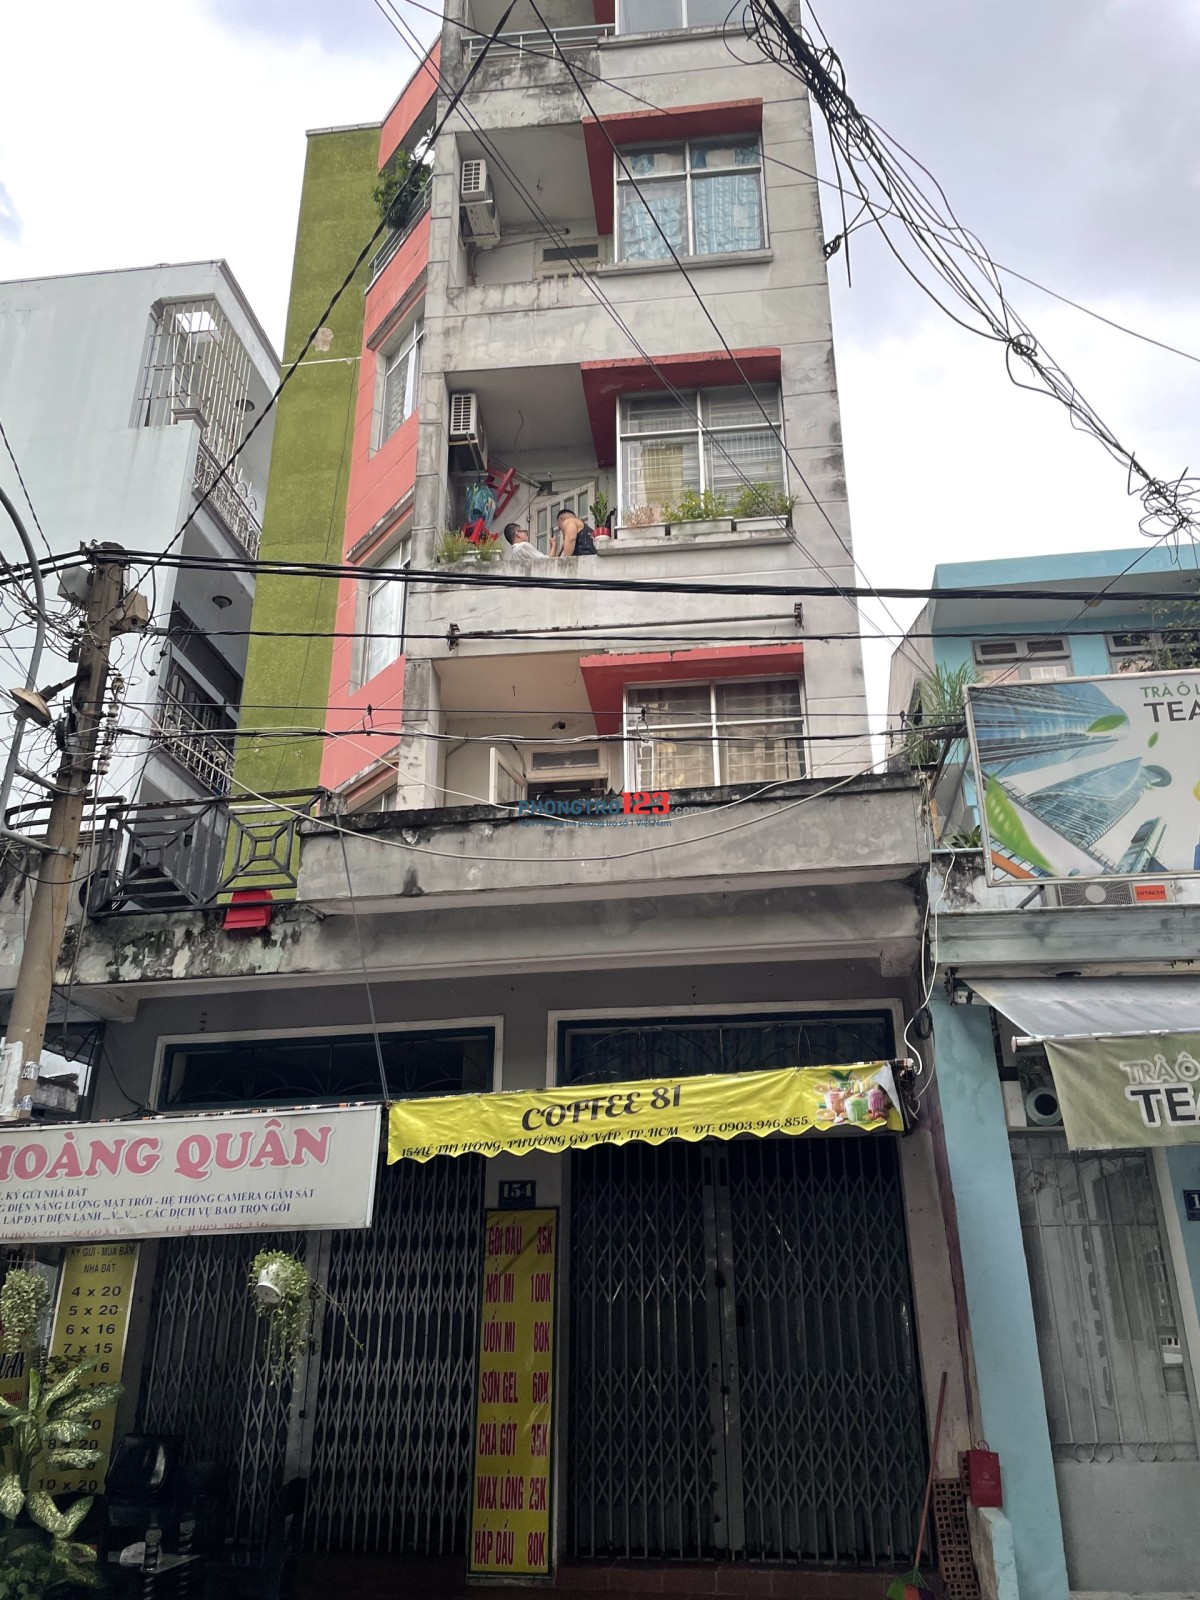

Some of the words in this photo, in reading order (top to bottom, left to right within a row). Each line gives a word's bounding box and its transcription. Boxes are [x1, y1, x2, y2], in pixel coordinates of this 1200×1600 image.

[1139, 682, 1174, 698] TRÀ
[1176, 681, 1191, 696] Ô
[1119, 1054, 1178, 1084] TRÀ
[521, 1091, 644, 1132] COFFEE
[650, 1084, 682, 1110] 81
[1127, 1085, 1200, 1125] TE
[174, 1118, 333, 1180] QUÂN
[217, 1191, 261, 1203] CAMERA
[503, 1183, 532, 1198] 154
[215, 1204, 237, 1216] BAO
[537, 1225, 553, 1255] 35K
[71, 1286, 81, 1298] 4
[87, 1288, 97, 1297] x
[101, 1285, 122, 1298] 20
[503, 1273, 515, 1303] MI
[530, 1272, 551, 1303] 100K
[68, 1305, 78, 1316] 5
[83, 1307, 93, 1316] x
[98, 1304, 119, 1316] 20
[65, 1324, 75, 1335] 6
[80, 1326, 90, 1335] x
[97, 1323, 116, 1335] 16
[503, 1321, 516, 1353] MI
[533, 1321, 551, 1353] 80K
[63, 1343, 73, 1354] 7
[78, 1345, 87, 1354] x
[94, 1342, 113, 1354] 15
[502, 1371, 518, 1403] GEL
[532, 1371, 549, 1403] 60K
[79, 1439, 99, 1450] 20
[530, 1423, 548, 1457] 35K
[38, 1479, 56, 1491] 10
[63, 1481, 72, 1491] x
[77, 1479, 98, 1491] 20
[477, 1476, 498, 1510] WAX
[499, 1468, 524, 1511] LÔNG
[528, 1476, 547, 1511] 25K
[527, 1531, 546, 1566] 80K
